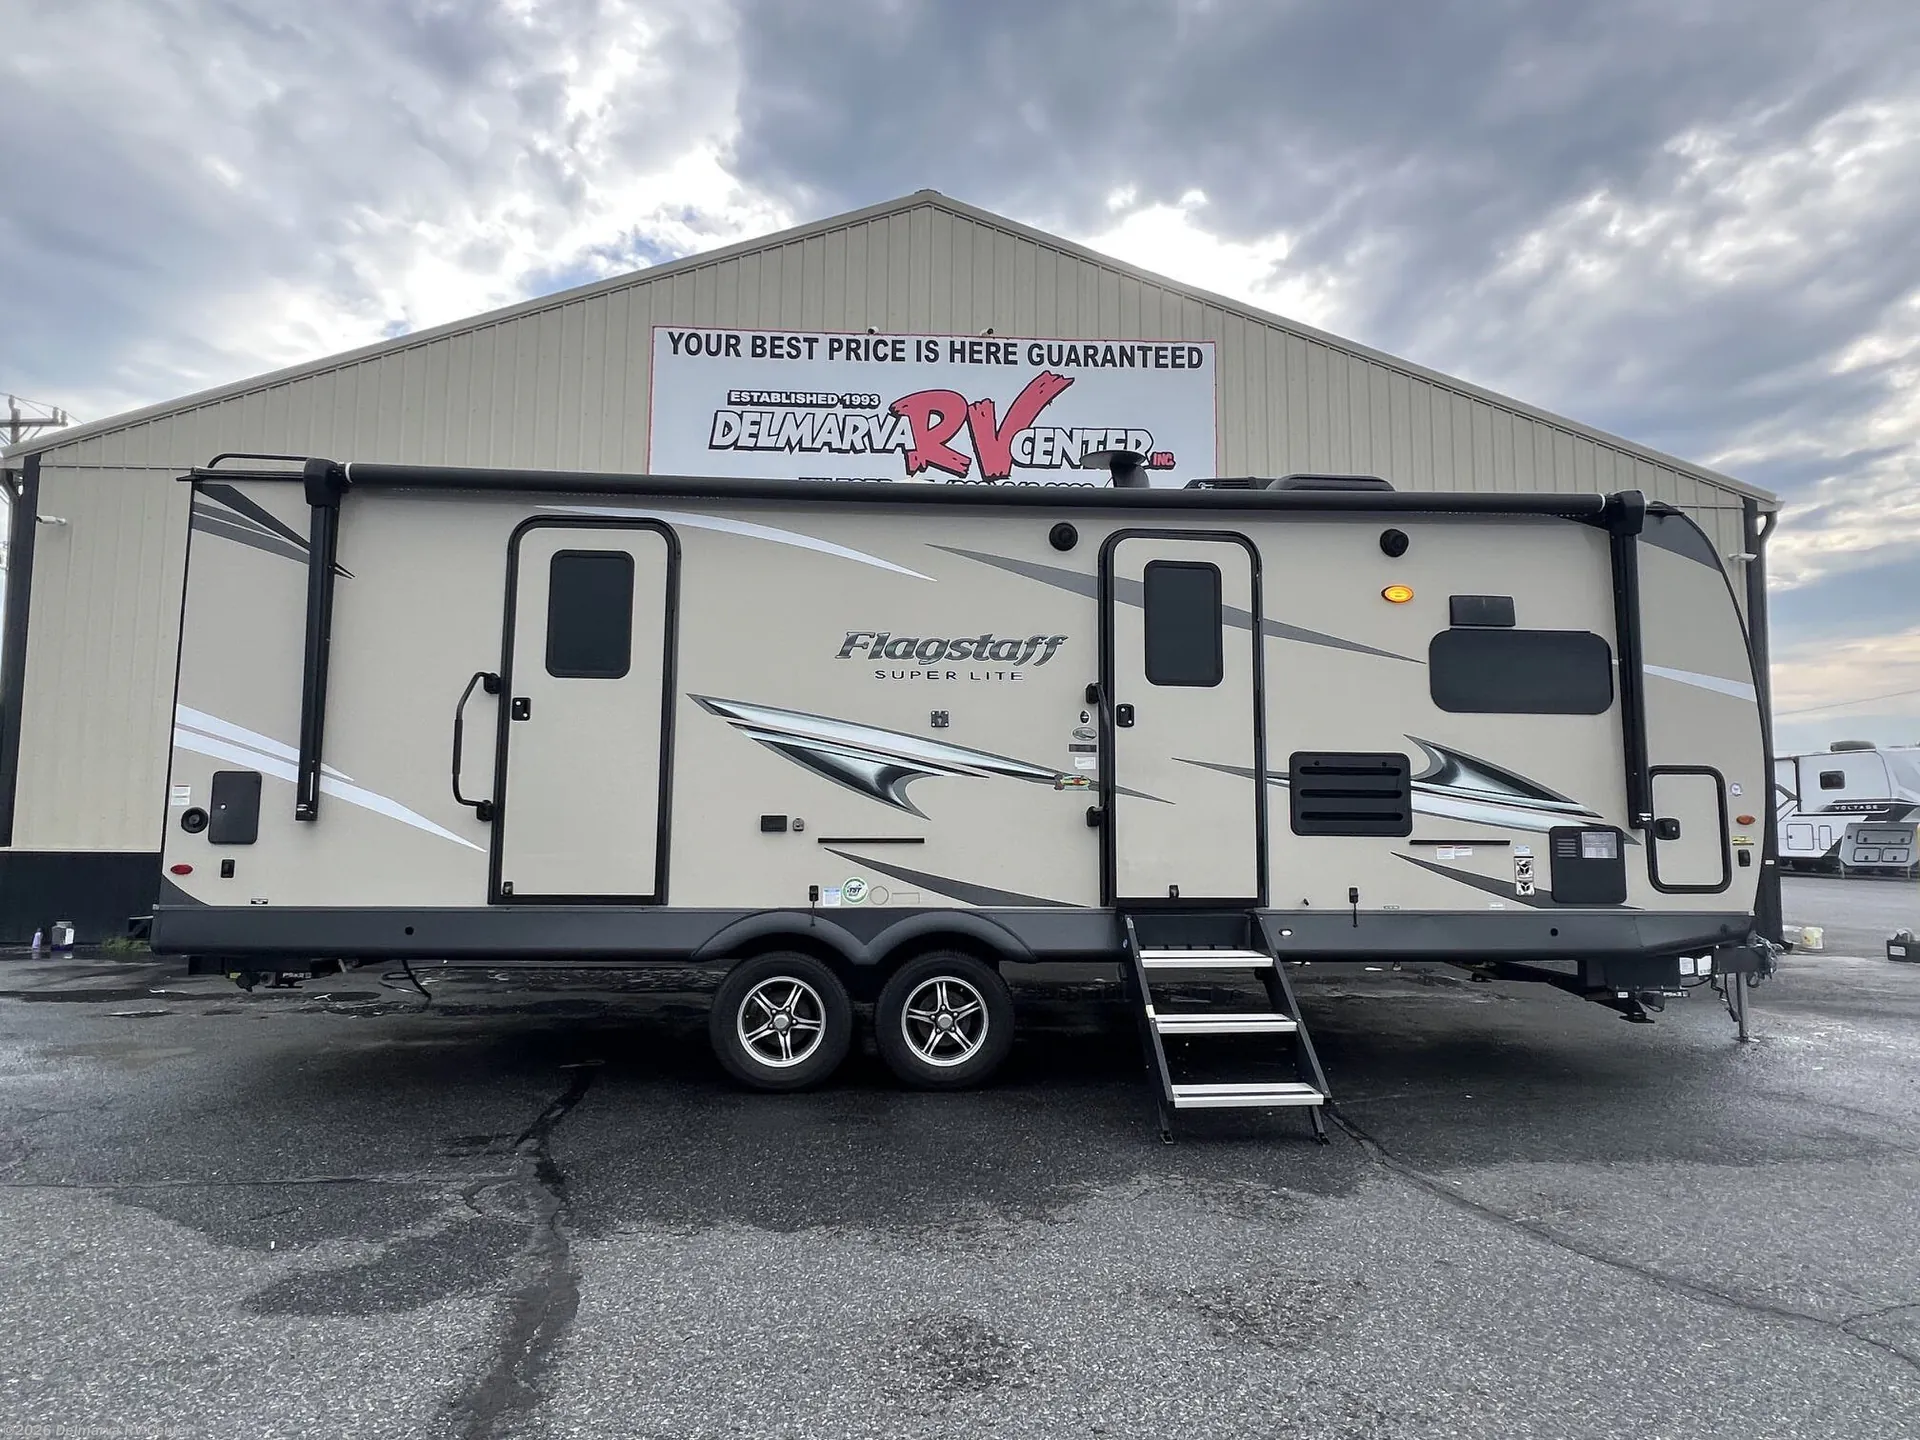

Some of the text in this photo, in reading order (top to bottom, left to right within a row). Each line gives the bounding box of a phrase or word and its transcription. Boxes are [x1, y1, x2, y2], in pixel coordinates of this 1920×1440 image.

[667, 331, 1204, 369] YOUR BEST PRICE IS HERE GUARANTEED
[728, 390, 881, 409] ESTABLISHED 1993
[709, 410, 917, 454] DELMARVA
[889, 370, 1075, 481] RV
[835, 631, 1068, 666] Flagstaff
[875, 670, 1024, 681] SUPER LITE
